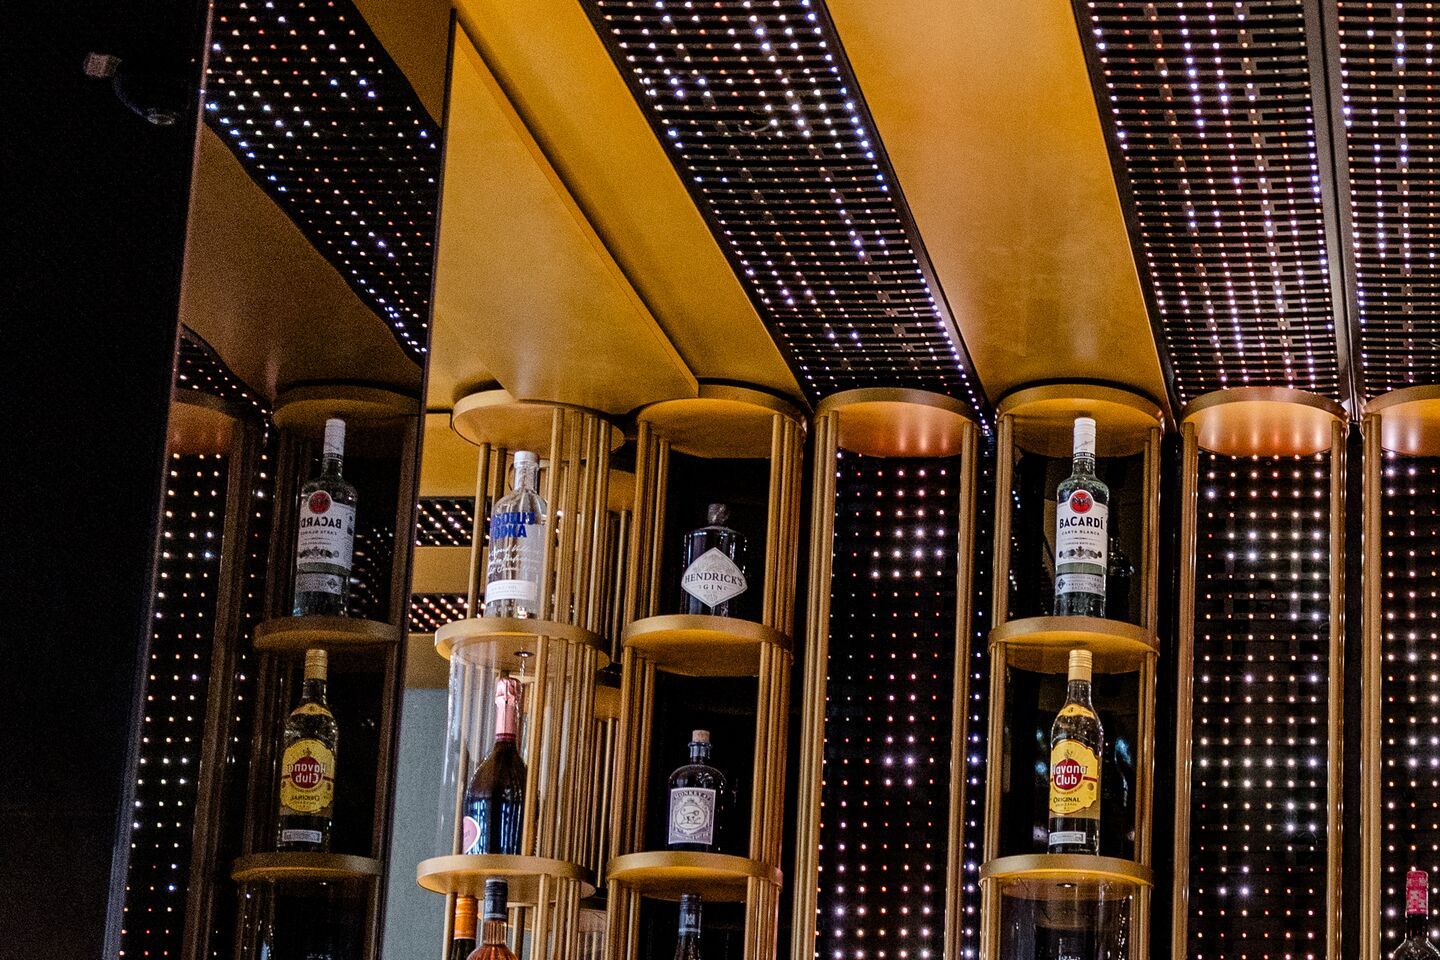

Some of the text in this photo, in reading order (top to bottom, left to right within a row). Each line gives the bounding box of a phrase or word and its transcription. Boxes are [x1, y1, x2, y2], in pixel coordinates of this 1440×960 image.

[1060, 517, 1103, 529] BACARDÍ
[685, 572, 743, 587] HENDRICK'S
[1053, 764, 1088, 774] Havana
[1056, 775, 1077, 785] Club
